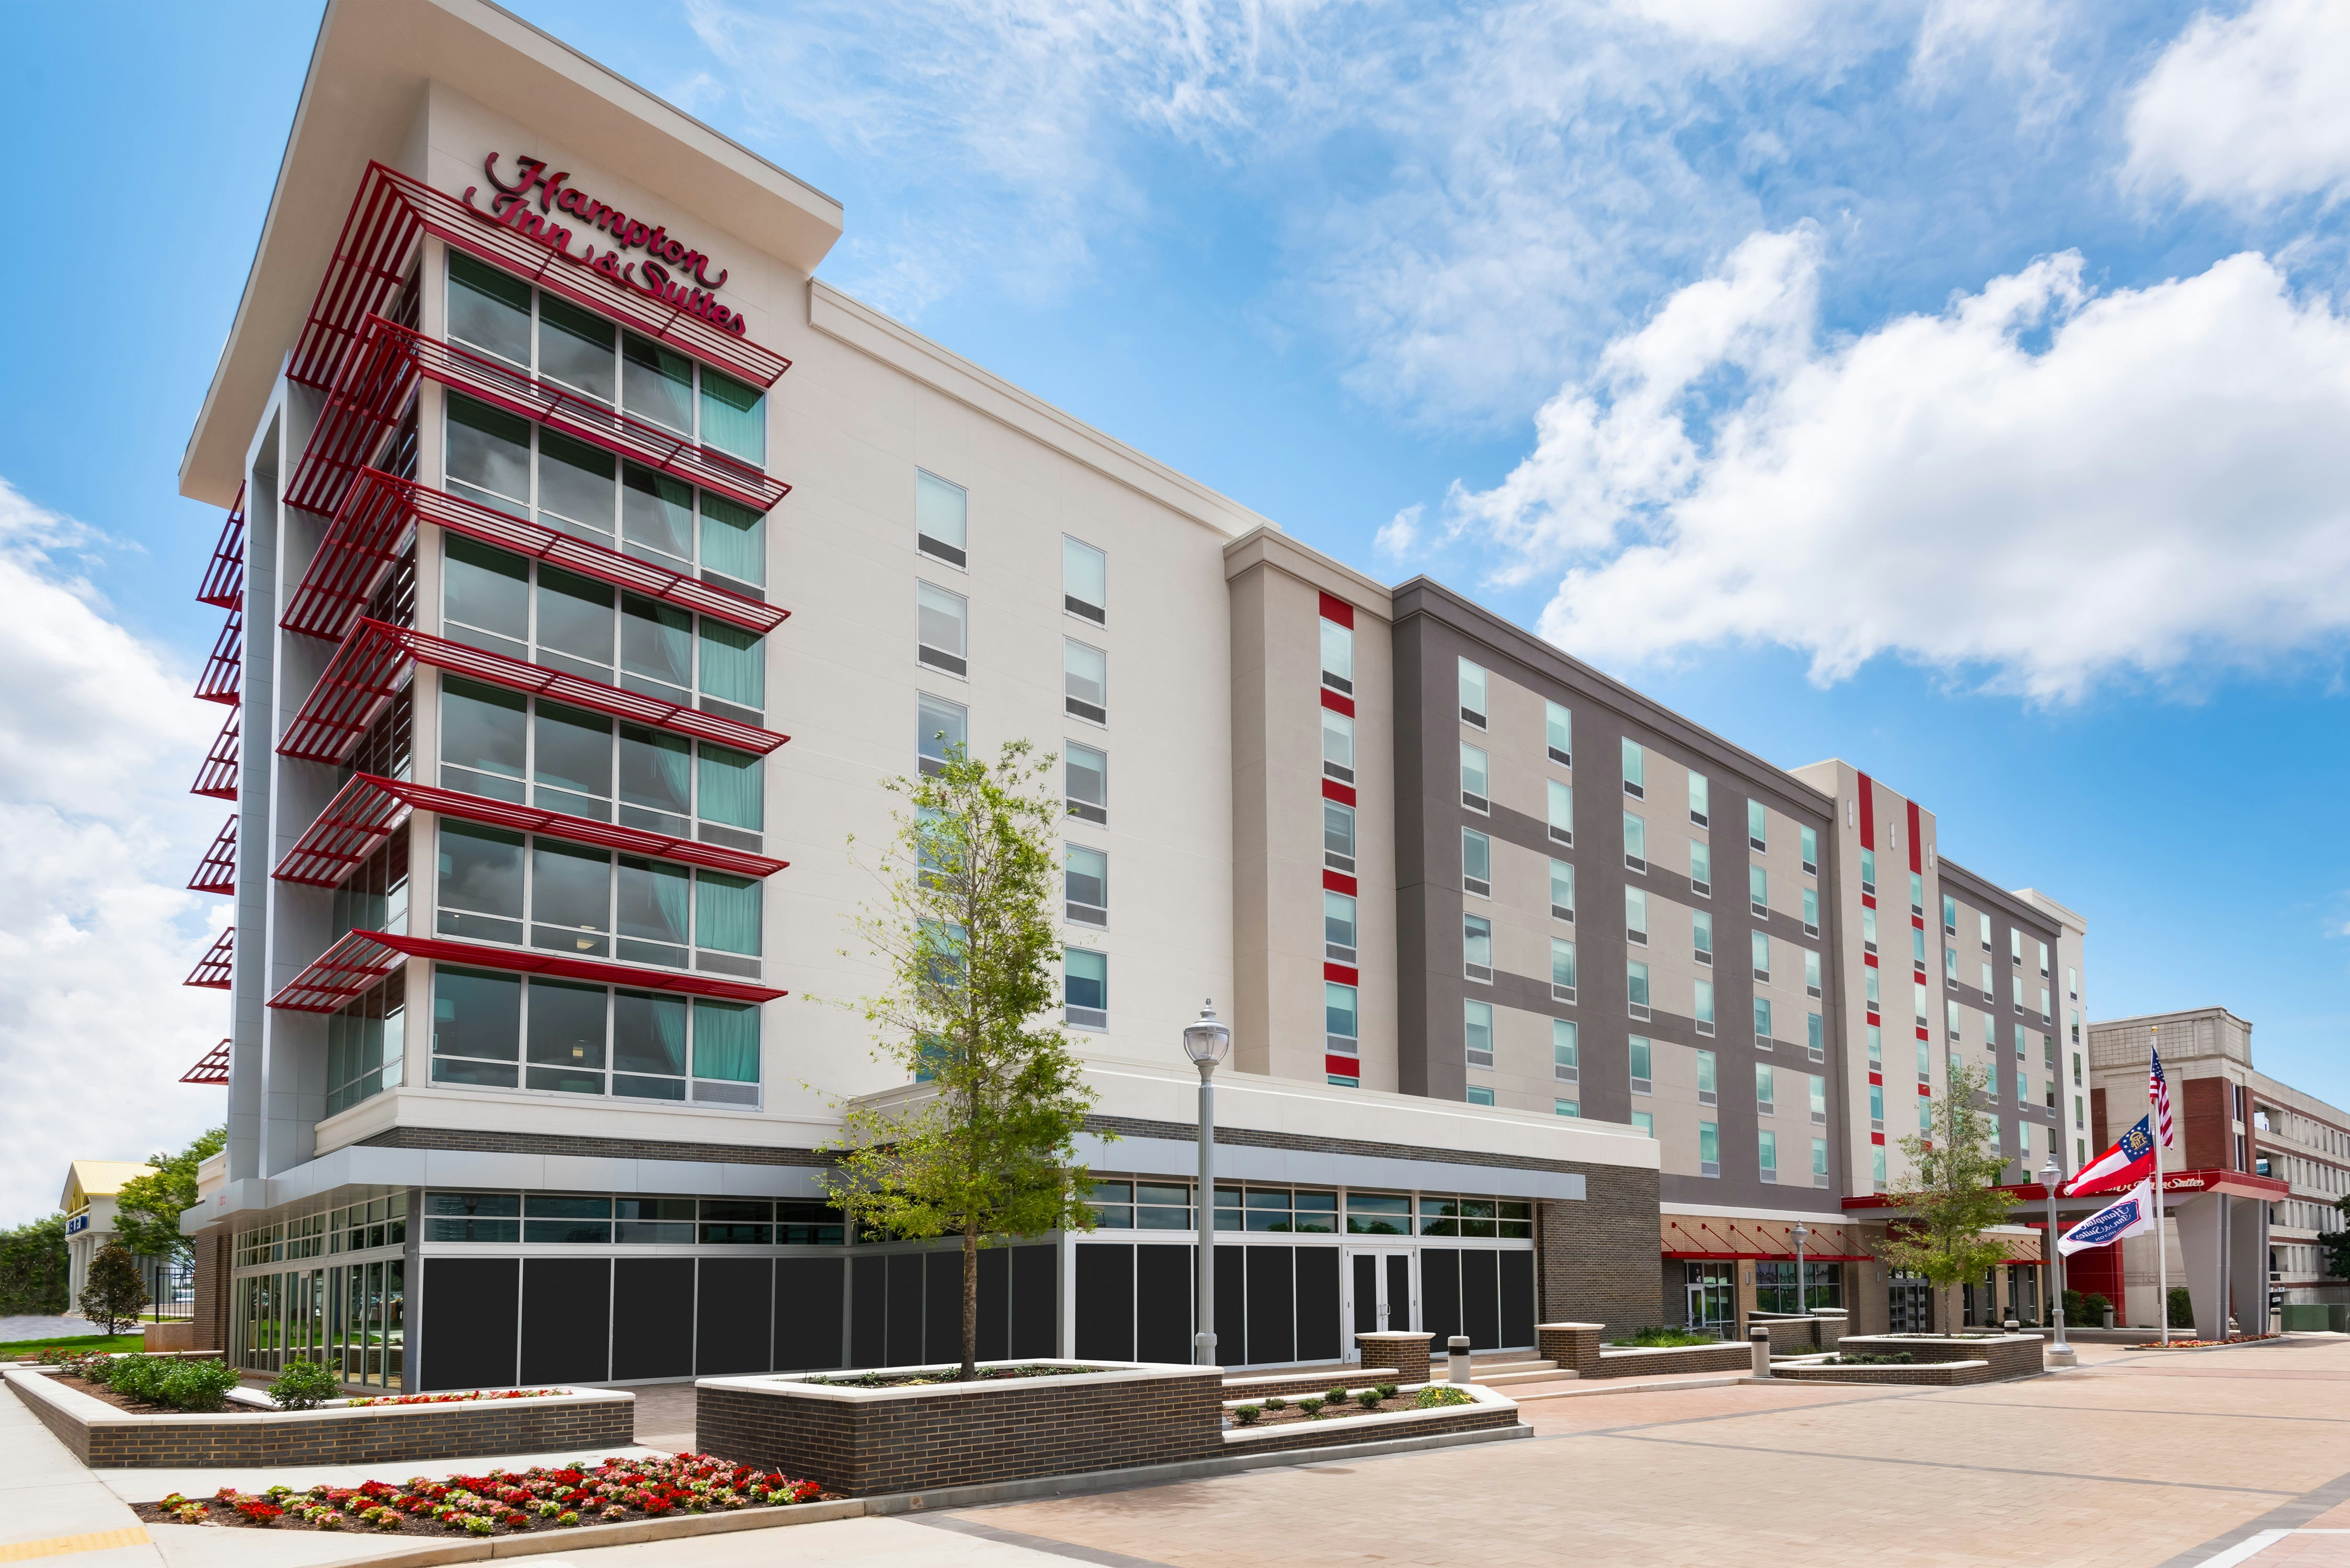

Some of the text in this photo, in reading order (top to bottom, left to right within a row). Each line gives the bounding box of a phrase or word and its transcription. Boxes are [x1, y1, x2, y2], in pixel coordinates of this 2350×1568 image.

[463, 186, 746, 336] Inn & Suites
[485, 152, 728, 290] Hampton
[2168, 1178, 2205, 1189] Suites
